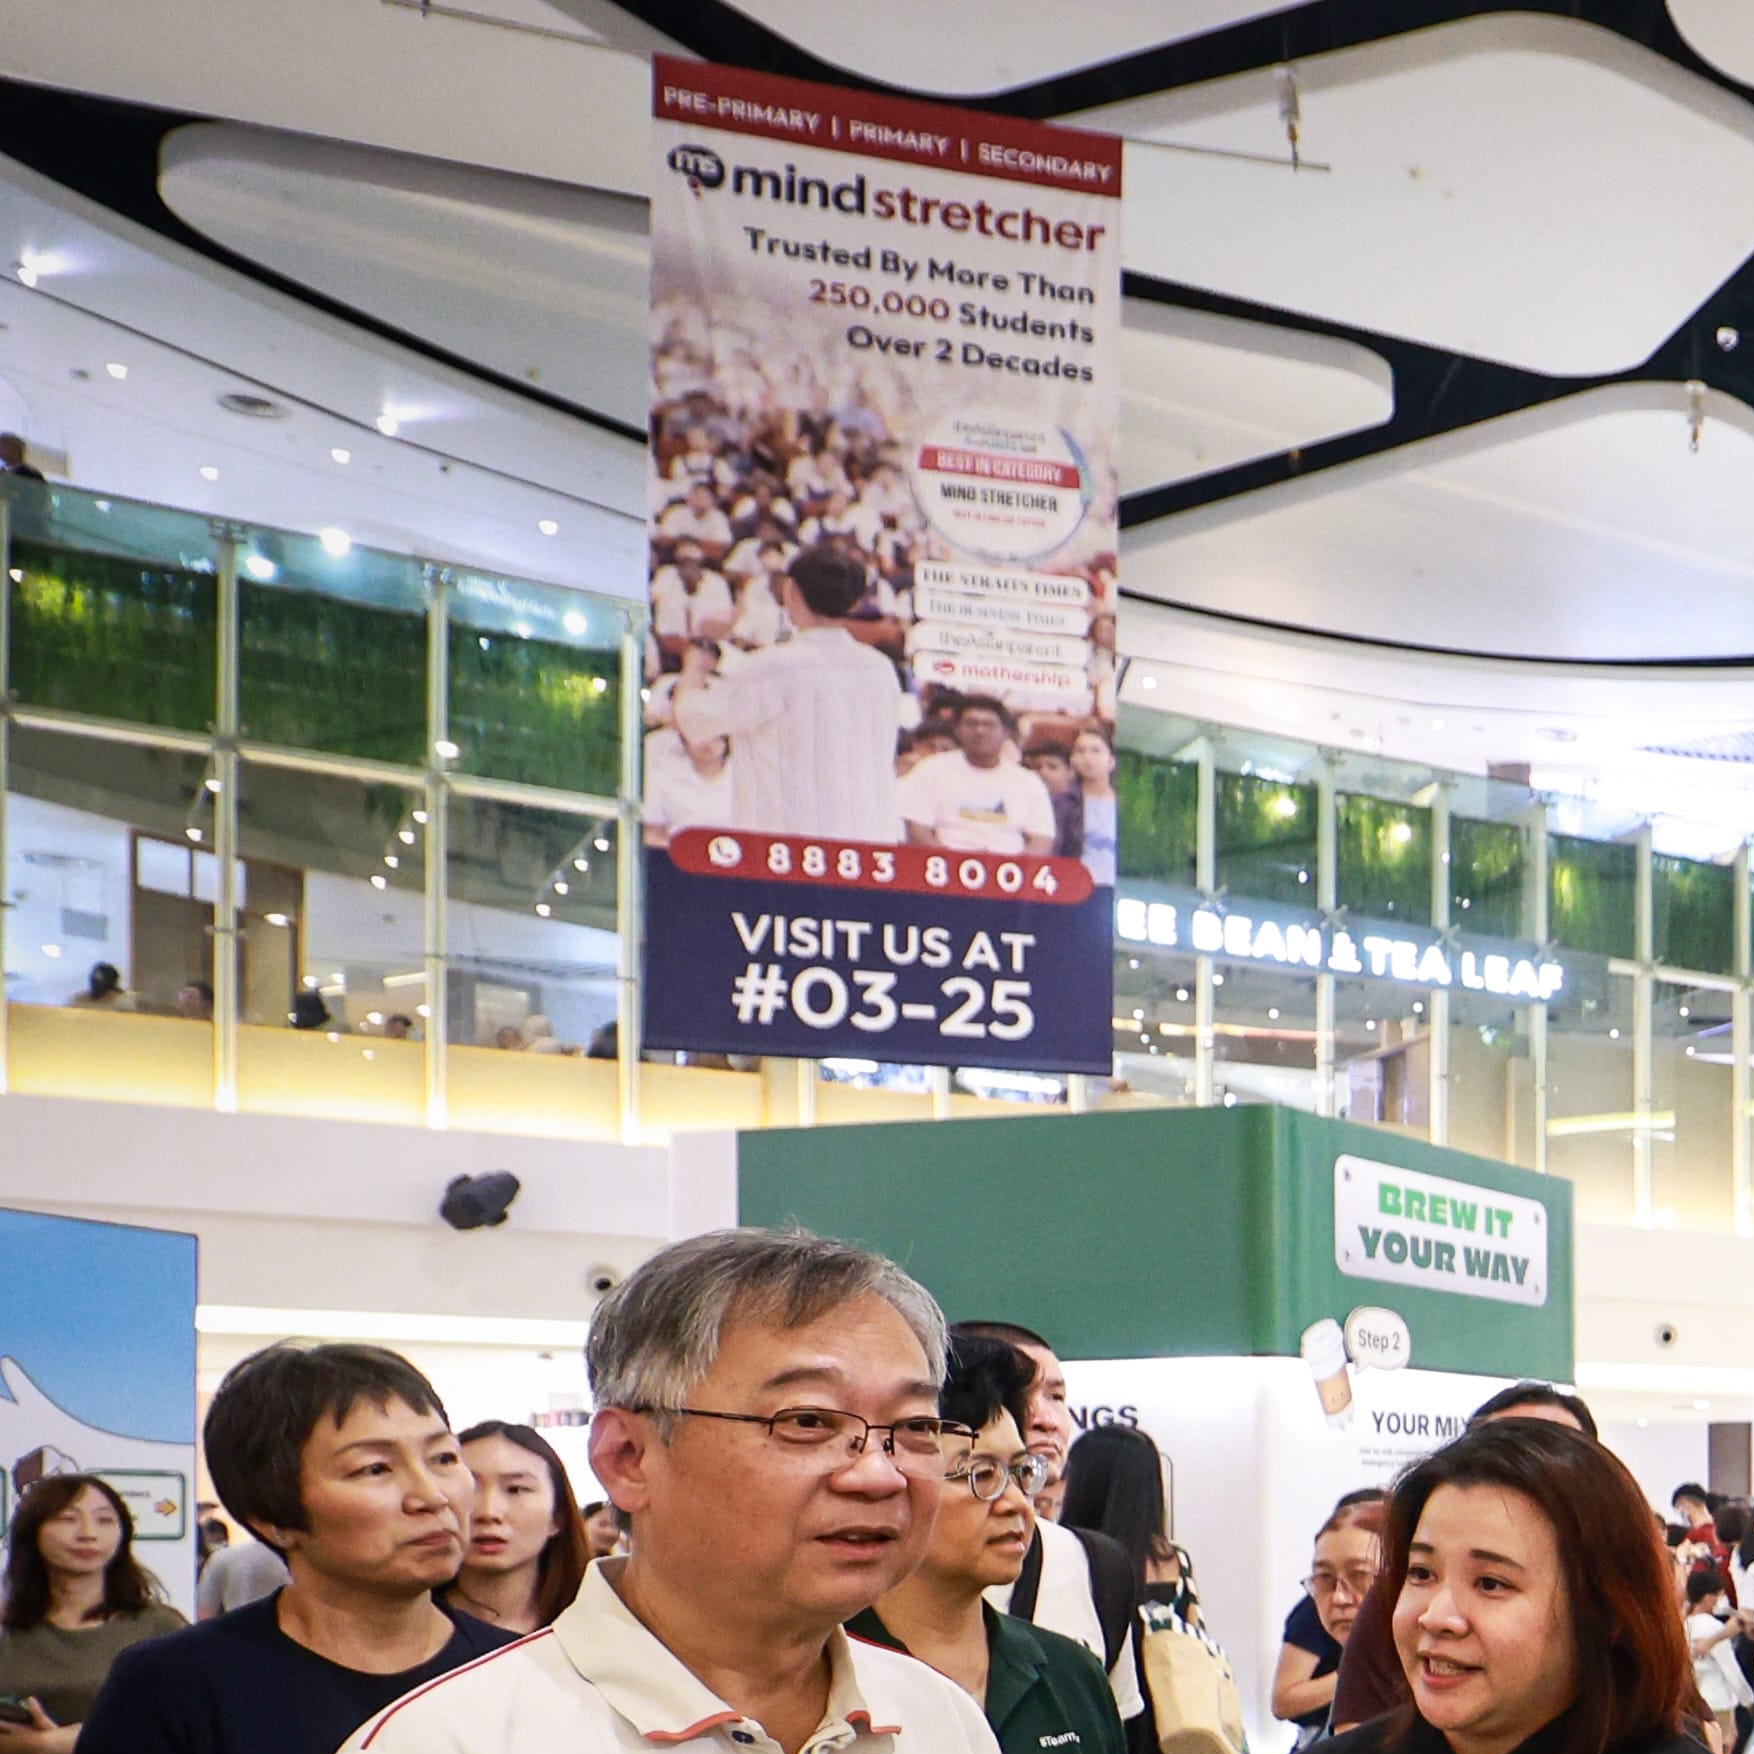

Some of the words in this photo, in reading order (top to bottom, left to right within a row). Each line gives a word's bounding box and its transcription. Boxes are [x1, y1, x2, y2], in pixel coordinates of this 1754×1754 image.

[663, 86, 820, 130] PRE-PRIMARY
[849, 119, 947, 155] PRIMARY
[978, 142, 1109, 182] SECONDARY
[743, 226, 871, 270] Trusted
[881, 250, 918, 281] By
[928, 258, 1008, 290] More
[1018, 272, 1094, 304] Than
[809, 279, 949, 320] 250,000
[960, 303, 1093, 343] Students
[846, 325, 925, 357] Over
[935, 338, 952, 363] 2
[962, 343, 1092, 382] Decades
[767, 842, 894, 882] 8883
[925, 856, 1056, 895] 8004
[731, 912, 871, 960] VISIT
[883, 924, 951, 967] US
[962, 931, 1035, 972] AT
[1192, 910, 1321, 966] BEAN
[1327, 931, 1361, 972] &
[1363, 936, 1451, 984] TEA
[1461, 951, 1562, 999] LEAF
[731, 963, 1033, 1040] #03-25
[1378, 1183, 1477, 1231] BREW
[1485, 1207, 1512, 1238] IT
[1358, 1225, 1455, 1273] YOUR
[1463, 1246, 1529, 1285] WAY
[1358, 1328, 1388, 1352] Step
[1392, 1332, 1399, 1350] 2
[1372, 1411, 1429, 1436] YOUR
